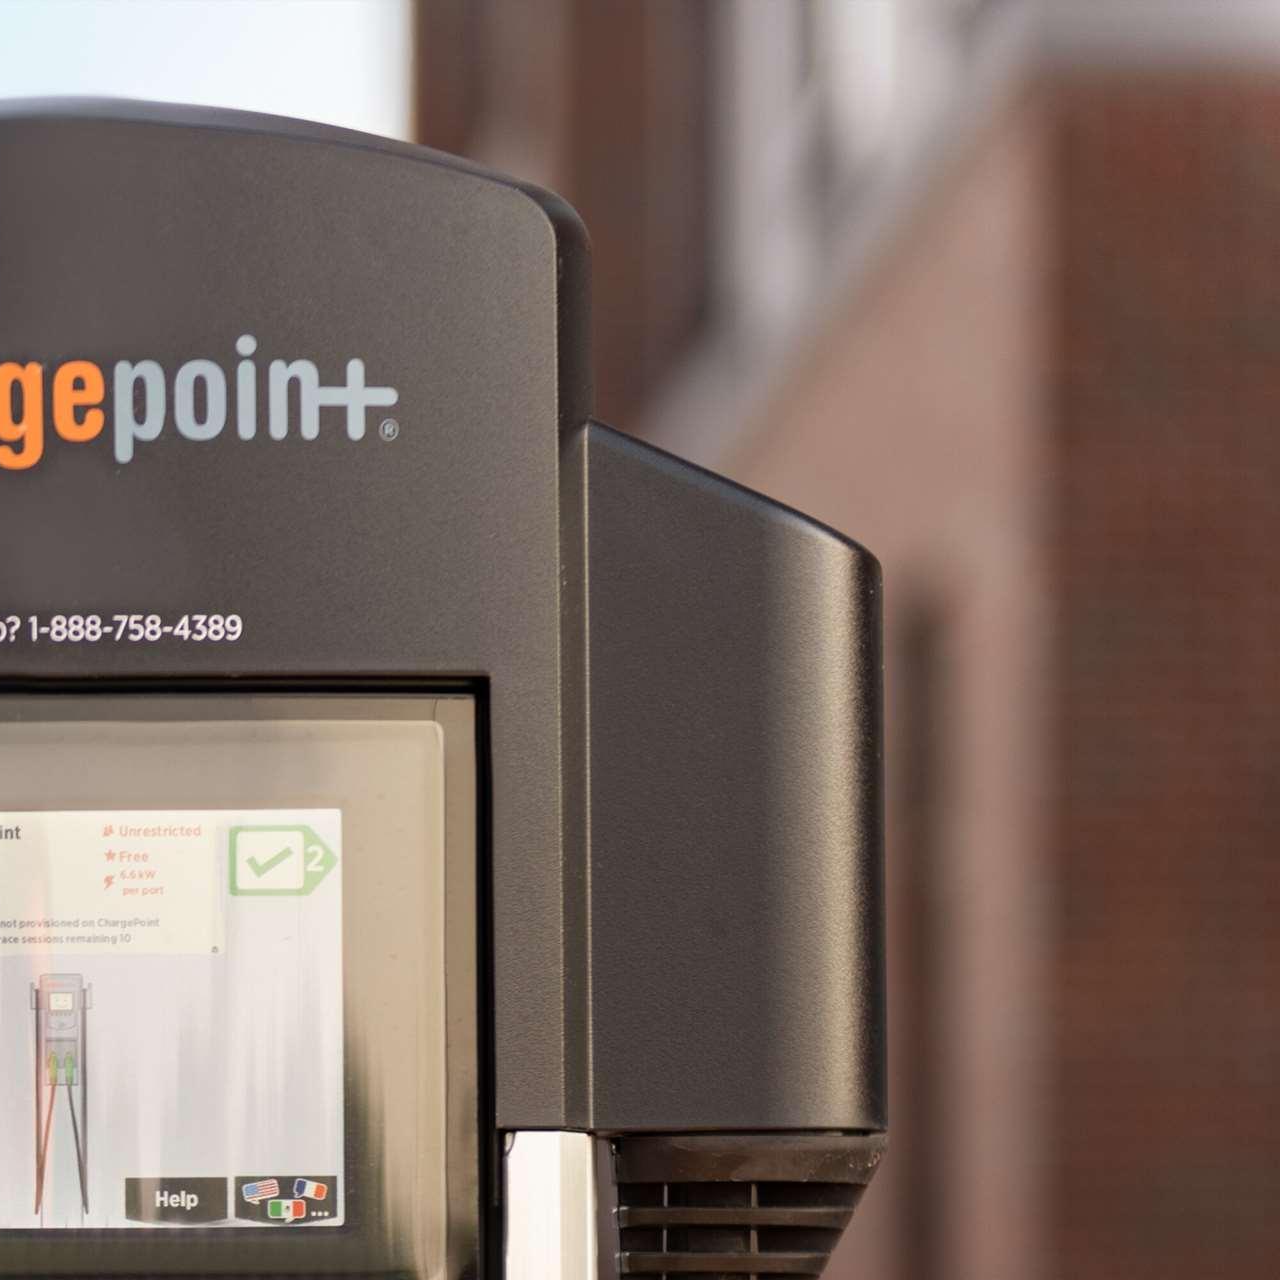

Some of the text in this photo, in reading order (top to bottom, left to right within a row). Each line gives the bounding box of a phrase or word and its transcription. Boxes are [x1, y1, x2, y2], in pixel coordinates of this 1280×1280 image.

[28, 614, 243, 642] 1-888-758-4389
[119, 825, 202, 837] Unrestricted
[119, 850, 149, 862] Free
[306, 844, 325, 871] 2
[122, 886, 165, 896] per port
[0, 918, 17, 929] not
[18, 918, 80, 931] provisioned
[81, 919, 95, 928] on
[97, 917, 160, 930] ChargePoint
[22, 933, 64, 944] sessions
[66, 932, 118, 944] remaining
[155, 1190, 199, 1210] Help
